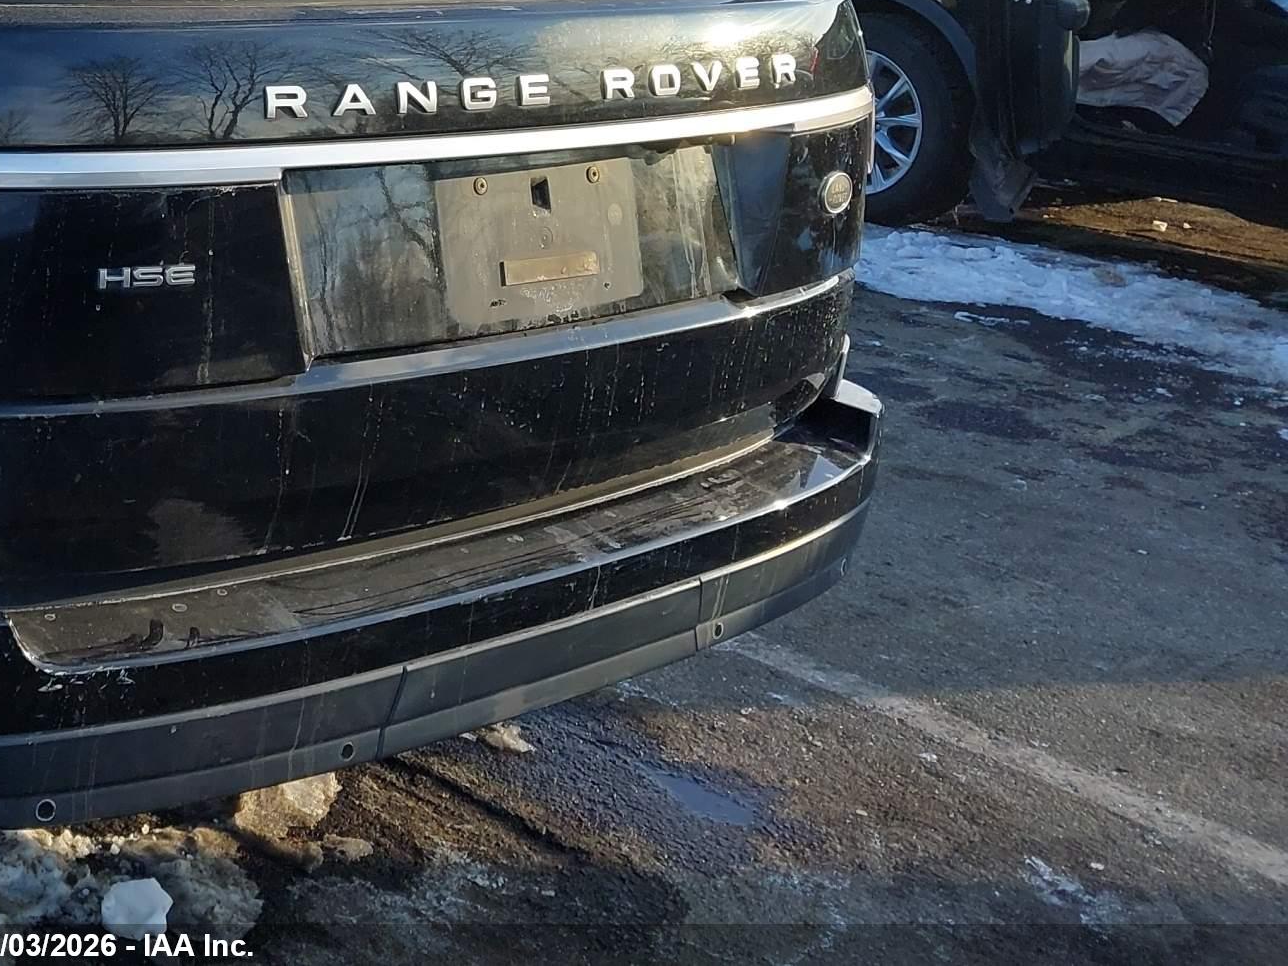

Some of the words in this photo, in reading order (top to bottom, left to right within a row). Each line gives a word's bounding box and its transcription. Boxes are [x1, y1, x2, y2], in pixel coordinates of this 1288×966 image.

[264, 73, 551, 119] RANGE
[600, 53, 797, 100] ROVER
[98, 264, 196, 289] HSE
